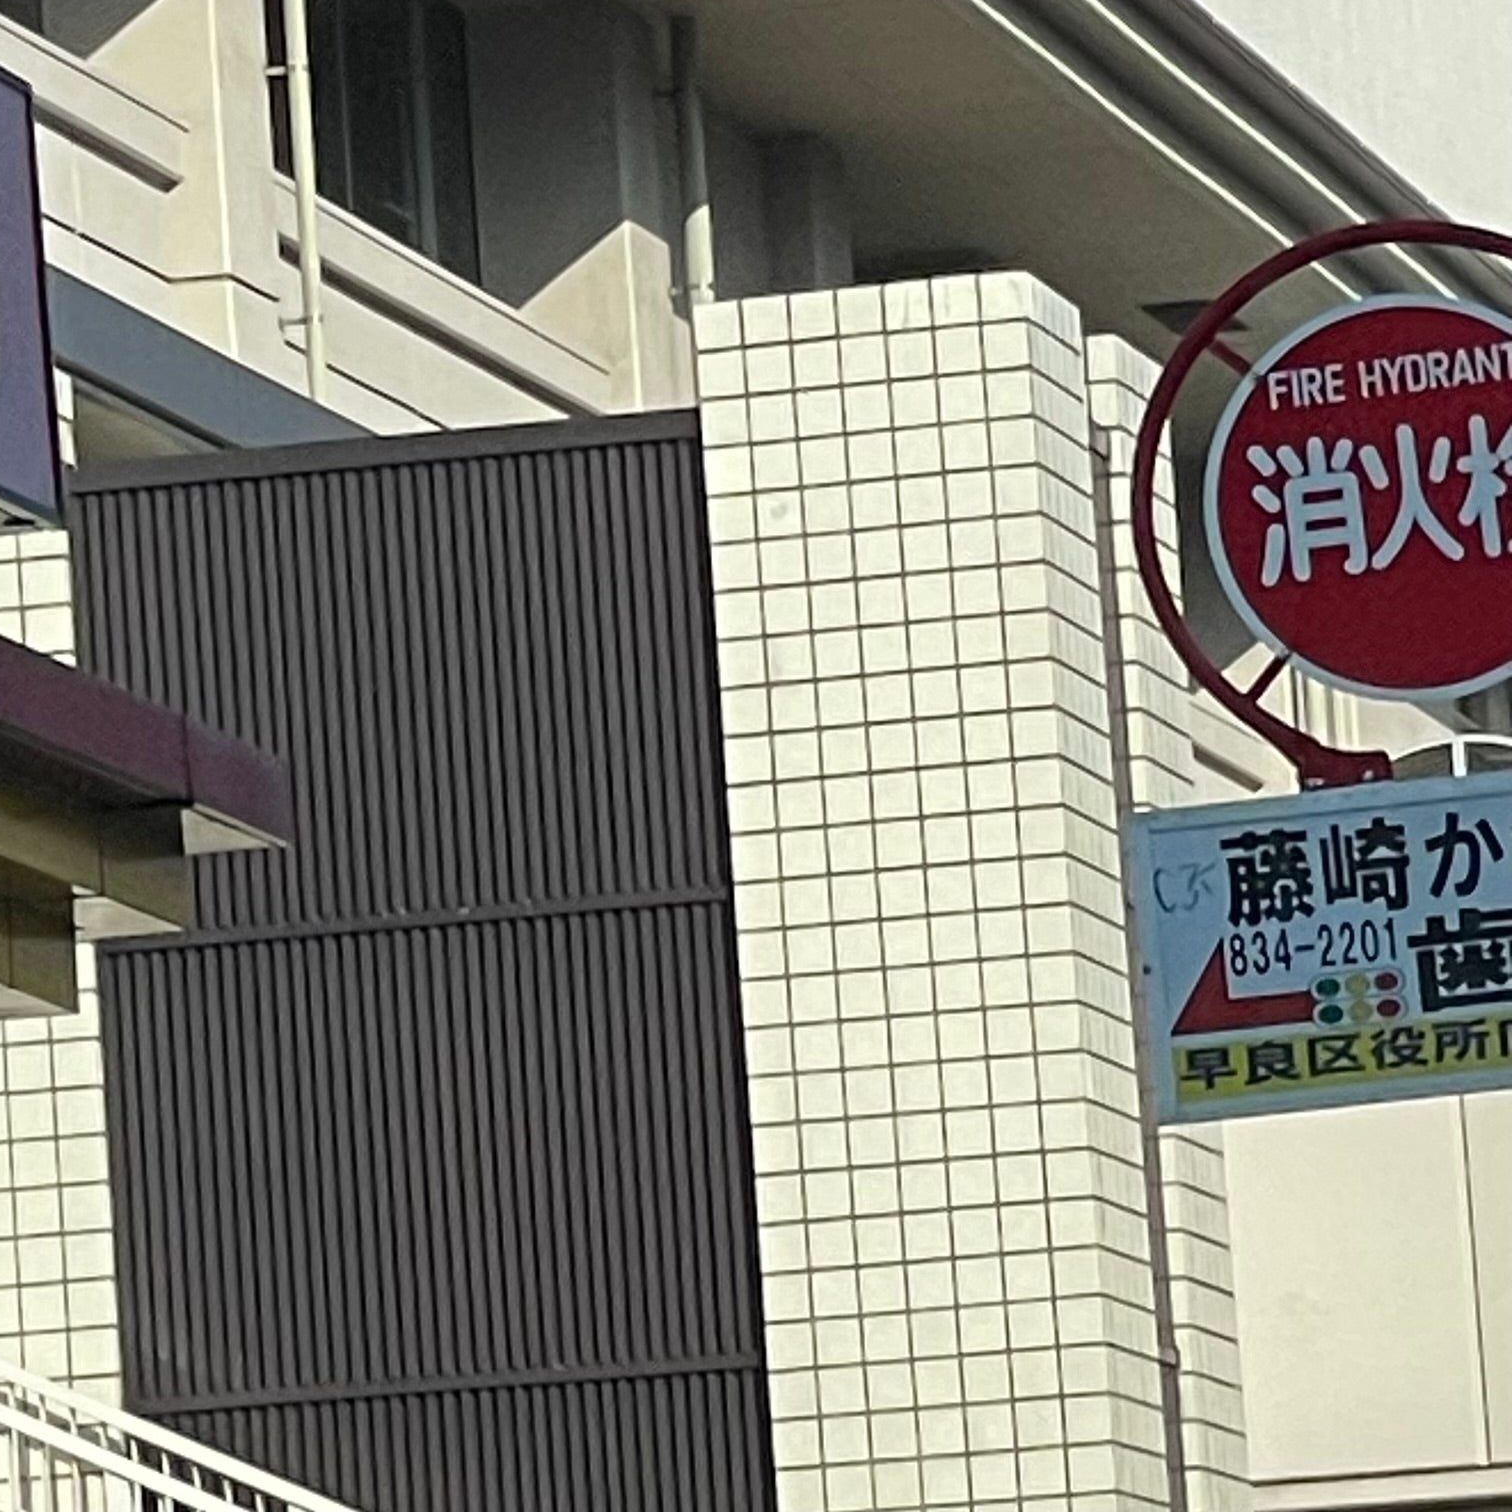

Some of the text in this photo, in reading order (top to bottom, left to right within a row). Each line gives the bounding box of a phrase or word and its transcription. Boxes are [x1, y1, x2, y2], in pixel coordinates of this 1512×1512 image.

[1266, 362, 1346, 411] FIRE
[1220, 812, 1504, 928] 藤崎か
[1229, 918, 1398, 977] 834-2201
[1180, 1018, 1512, 1090] 早良区役所
